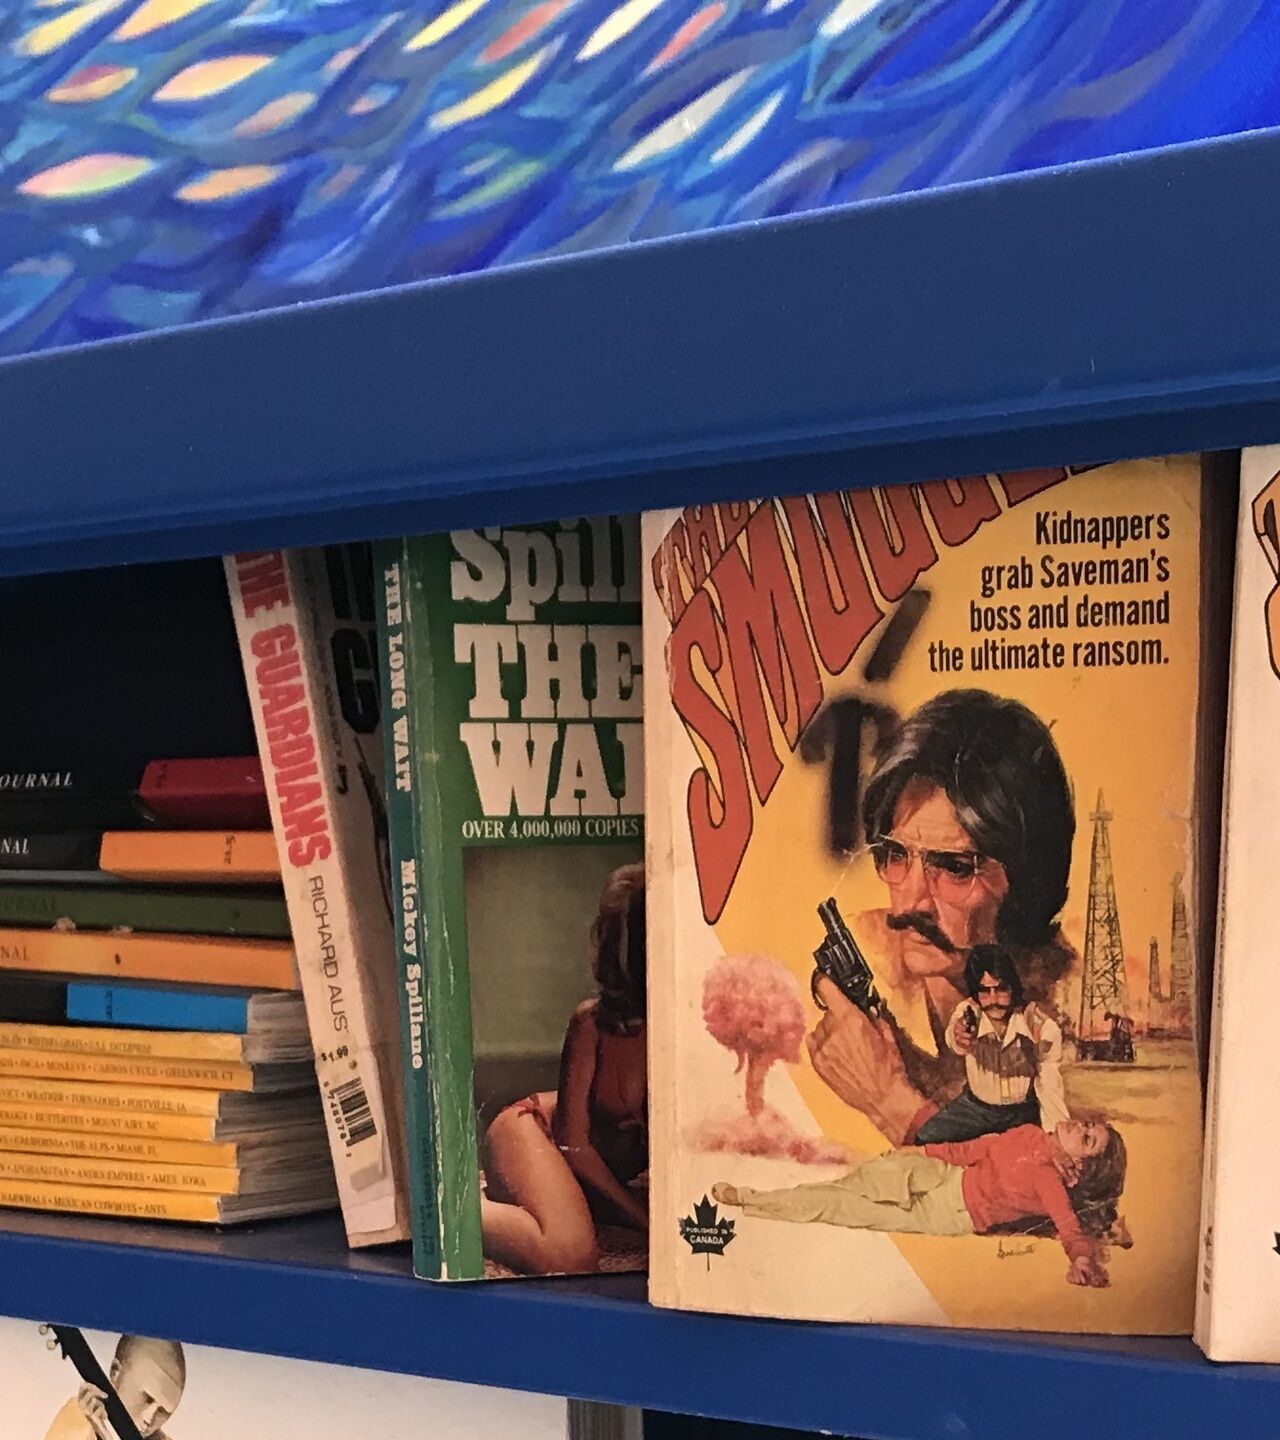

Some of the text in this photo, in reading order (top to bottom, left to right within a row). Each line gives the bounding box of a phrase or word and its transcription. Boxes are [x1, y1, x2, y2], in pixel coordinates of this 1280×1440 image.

[1036, 511, 1170, 547] Kidnappers
[981, 549, 1170, 598] grab Saveman's
[969, 591, 1170, 632] boss and demand
[453, 622, 643, 718] THE
[928, 637, 1170, 671] the ultimate ransom.
[384, 563, 412, 793] THE LONG WAIT
[250, 623, 333, 868] GUARDIANS
[462, 818, 640, 840] OVER 4,000,000 COPIES
[308, 874, 349, 1034] RICHARD AUS
[400, 858, 424, 1070] Mickey Spillane
[321, 1046, 349, 1062] $1.99
[91, 1117, 122, 1129] MOUNT
[107, 1170, 207, 1187] EMPIRES IOWA
[94, 1199, 137, 1212] COWBOYS
[144, 1204, 168, 1215] ANTS
[689, 1234, 725, 1245] CANADA
